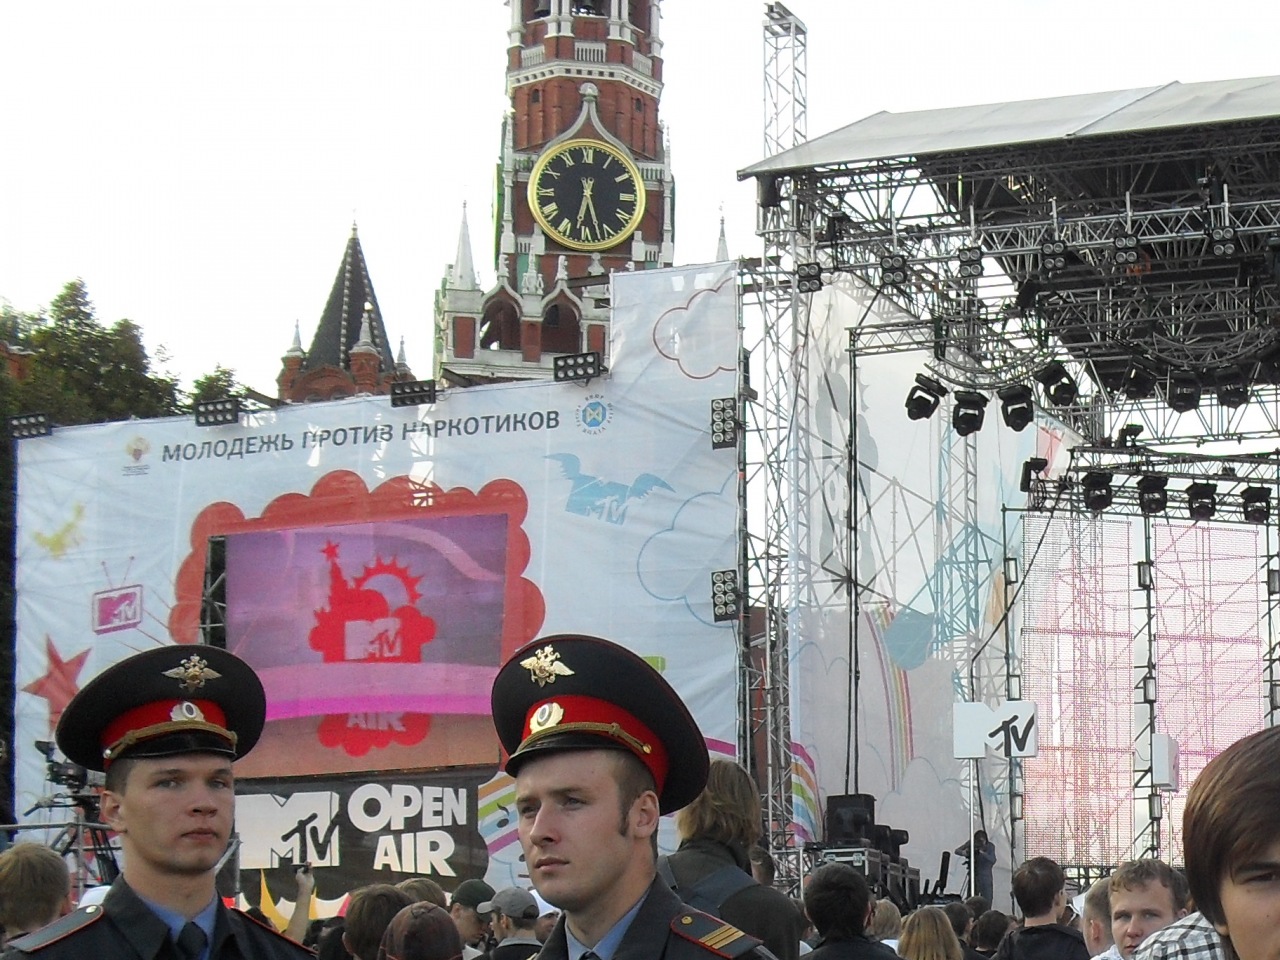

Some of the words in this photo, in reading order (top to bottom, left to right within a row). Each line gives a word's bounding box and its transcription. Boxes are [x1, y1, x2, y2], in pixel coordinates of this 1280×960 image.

[162, 433, 295, 463] МОЛОДЕЖЬ
[301, 423, 394, 450] ПРОТИВ
[344, 617, 402, 661] MTV
[953, 700, 1038, 759] MTV
[234, 791, 340, 870] MTV
[347, 783, 467, 833] OPEN
[373, 830, 457, 877] AIR
